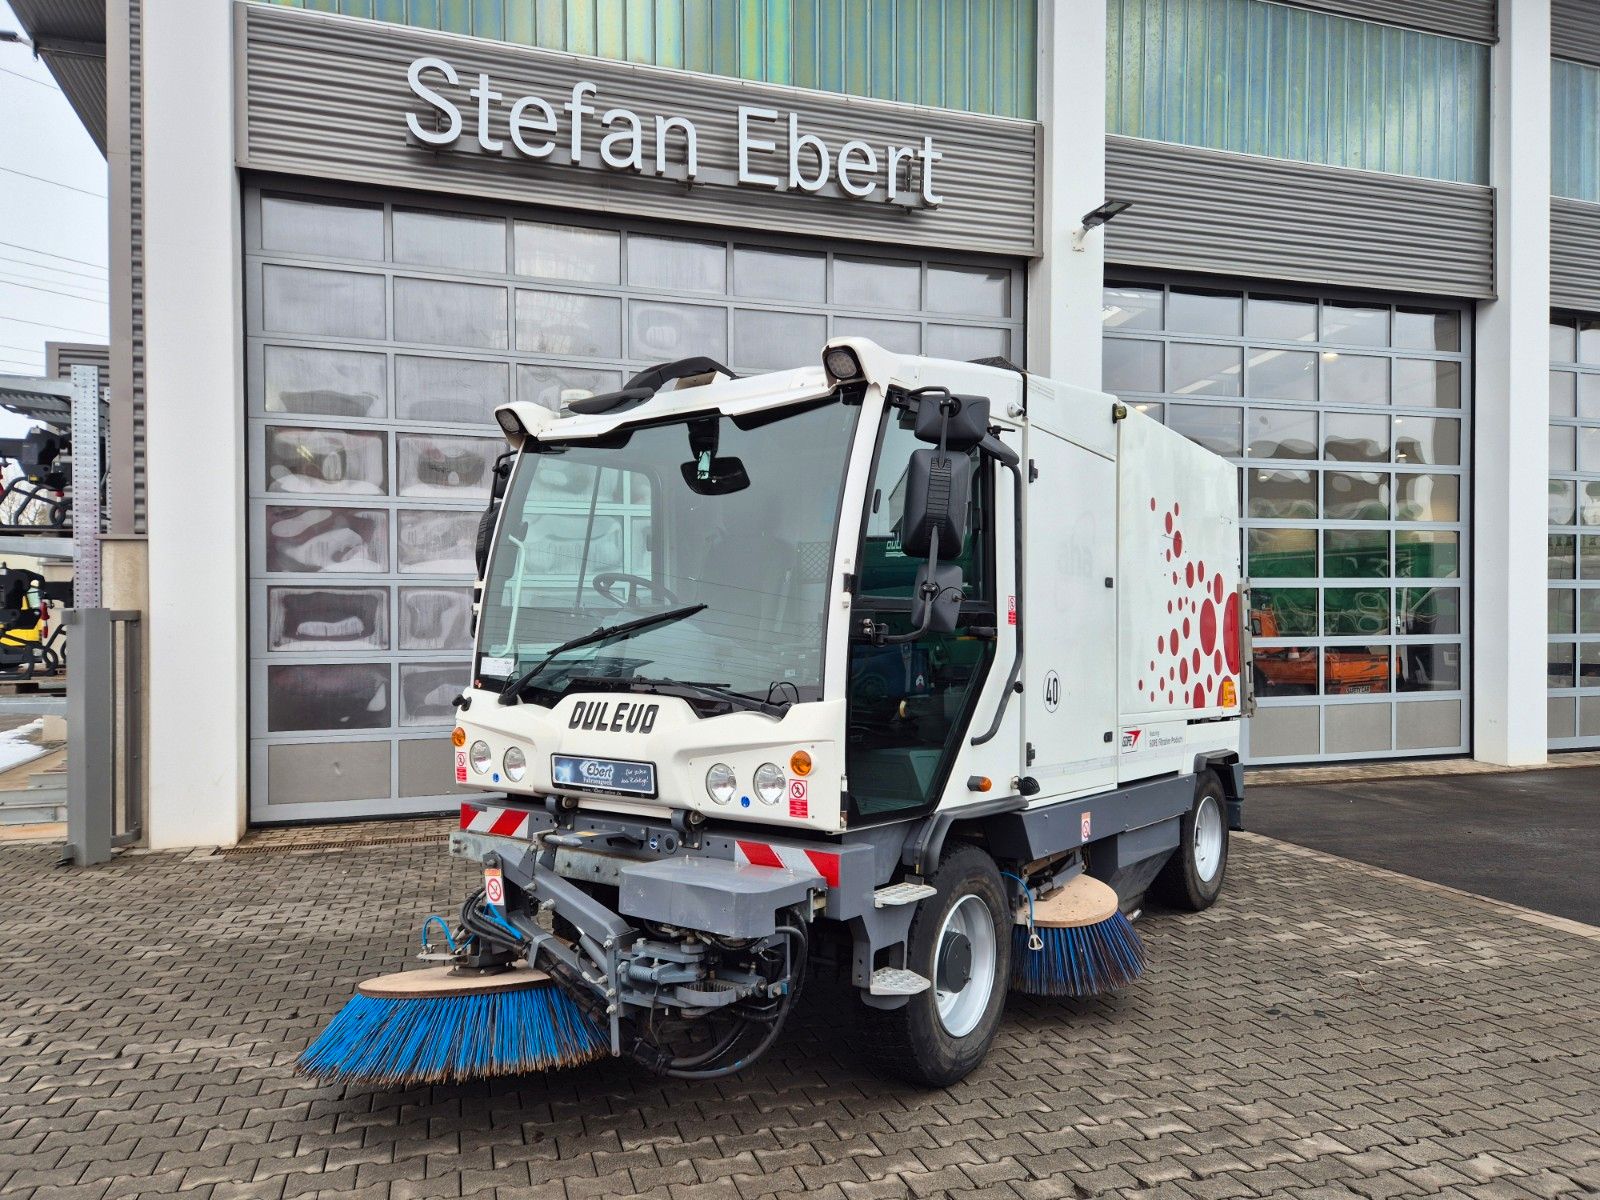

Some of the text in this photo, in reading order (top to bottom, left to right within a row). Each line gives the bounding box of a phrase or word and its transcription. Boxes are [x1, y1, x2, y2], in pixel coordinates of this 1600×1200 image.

[405, 57, 943, 205] Stefan Ebert
[1046, 677, 1058, 705] 40
[568, 701, 659, 734] DULEVO
